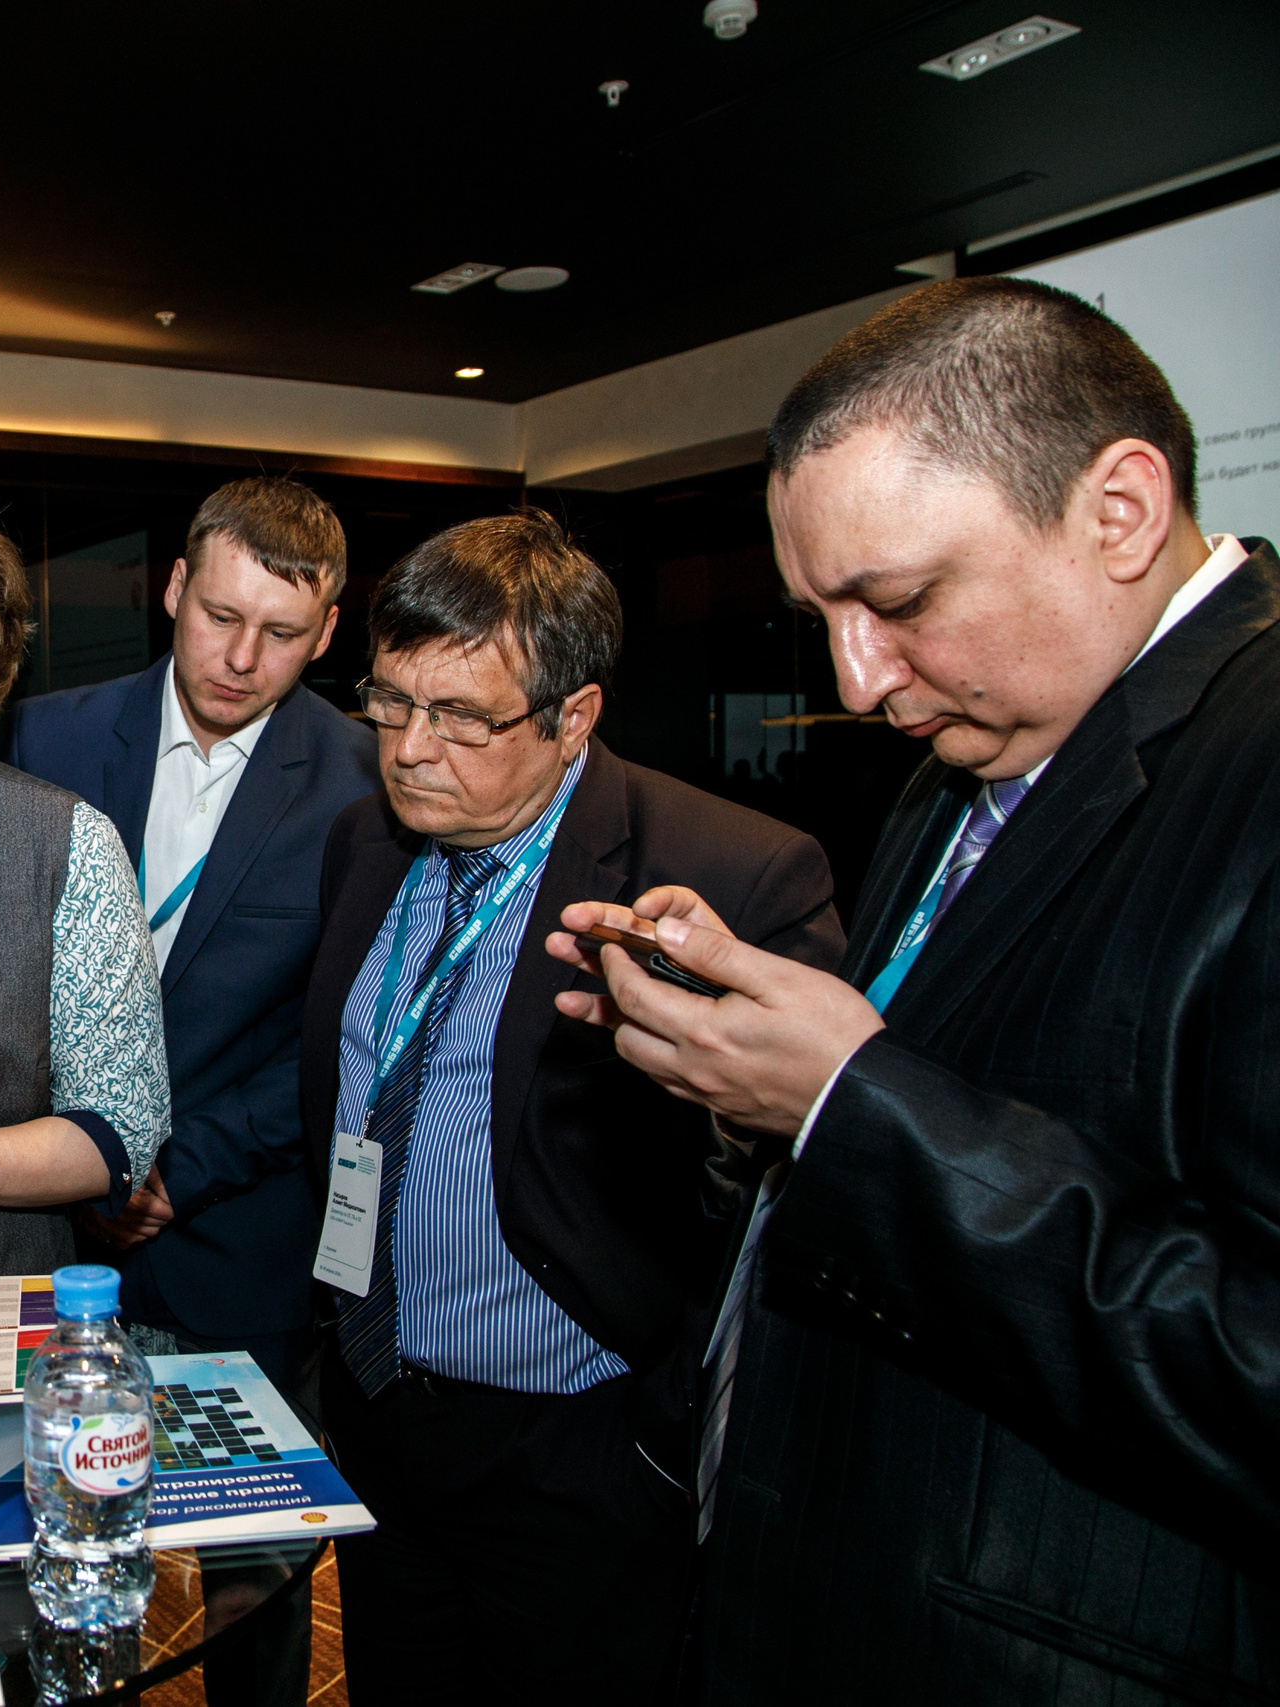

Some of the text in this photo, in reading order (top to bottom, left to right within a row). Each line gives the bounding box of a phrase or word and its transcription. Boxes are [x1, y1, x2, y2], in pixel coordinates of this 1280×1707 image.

[493, 862, 527, 906] СИБУР
[448, 918, 483, 962] СИБУР
[410, 975, 439, 1021] СИБУР
[379, 1034, 405, 1079] СИБУР
[184, 1495, 312, 1514] рекомендаций
[225, 1483, 303, 1498] правил
